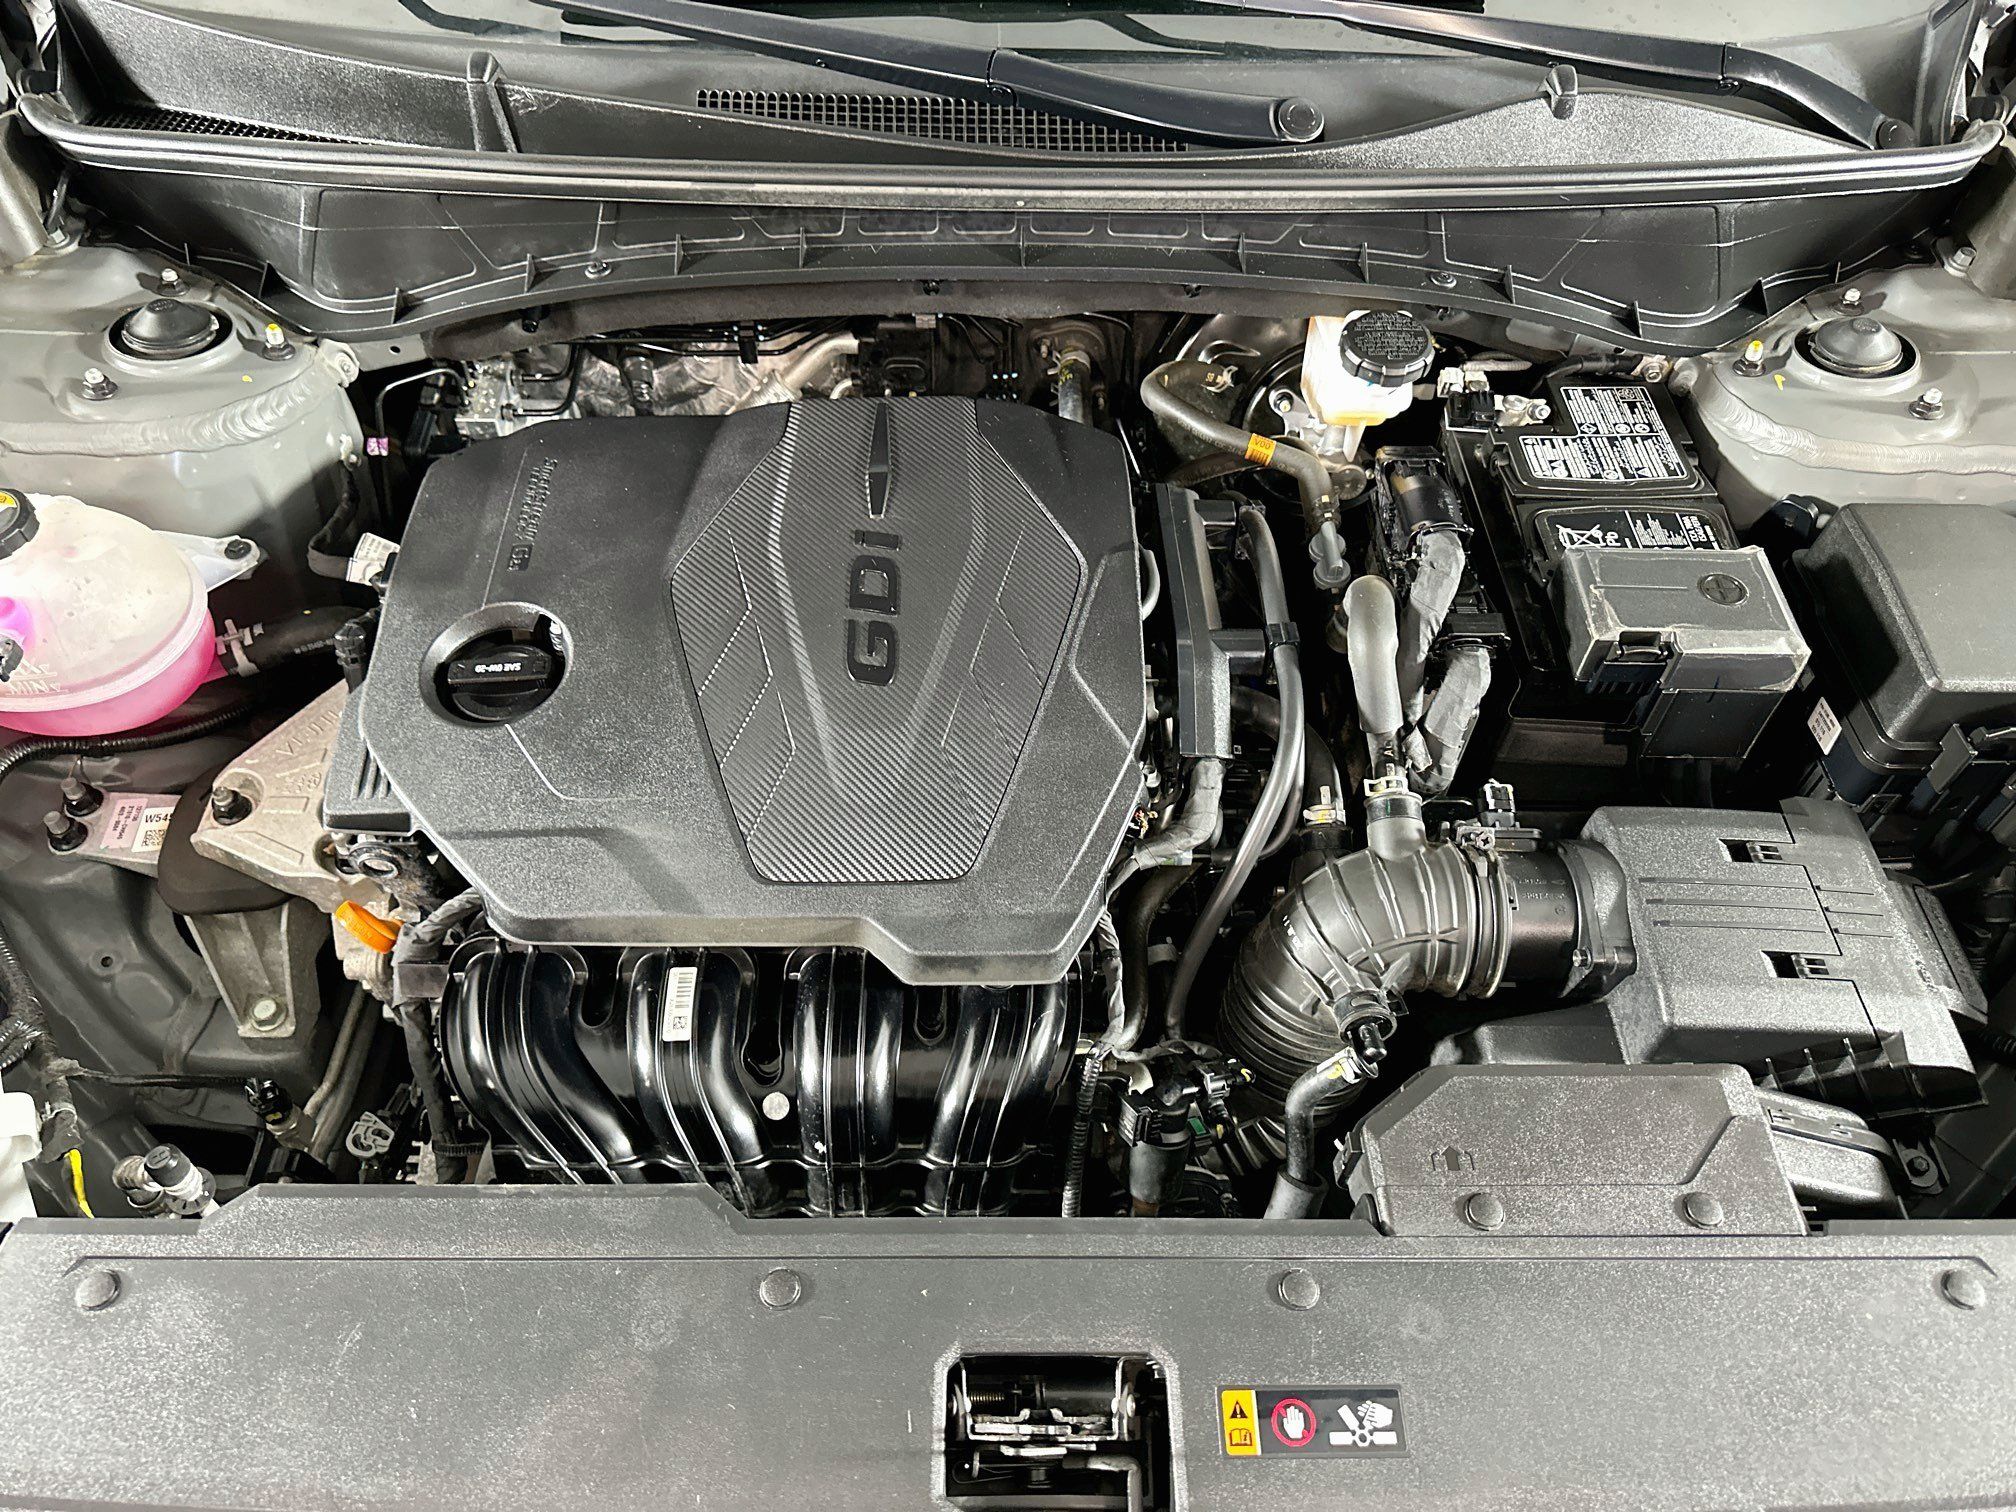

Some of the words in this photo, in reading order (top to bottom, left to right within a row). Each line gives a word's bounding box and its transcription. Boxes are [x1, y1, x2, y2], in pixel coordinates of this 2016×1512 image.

[1604, 531, 1621, 547] Pb
[474, 663, 503, 674] 0W-20
[503, 662, 522, 672] SAE
